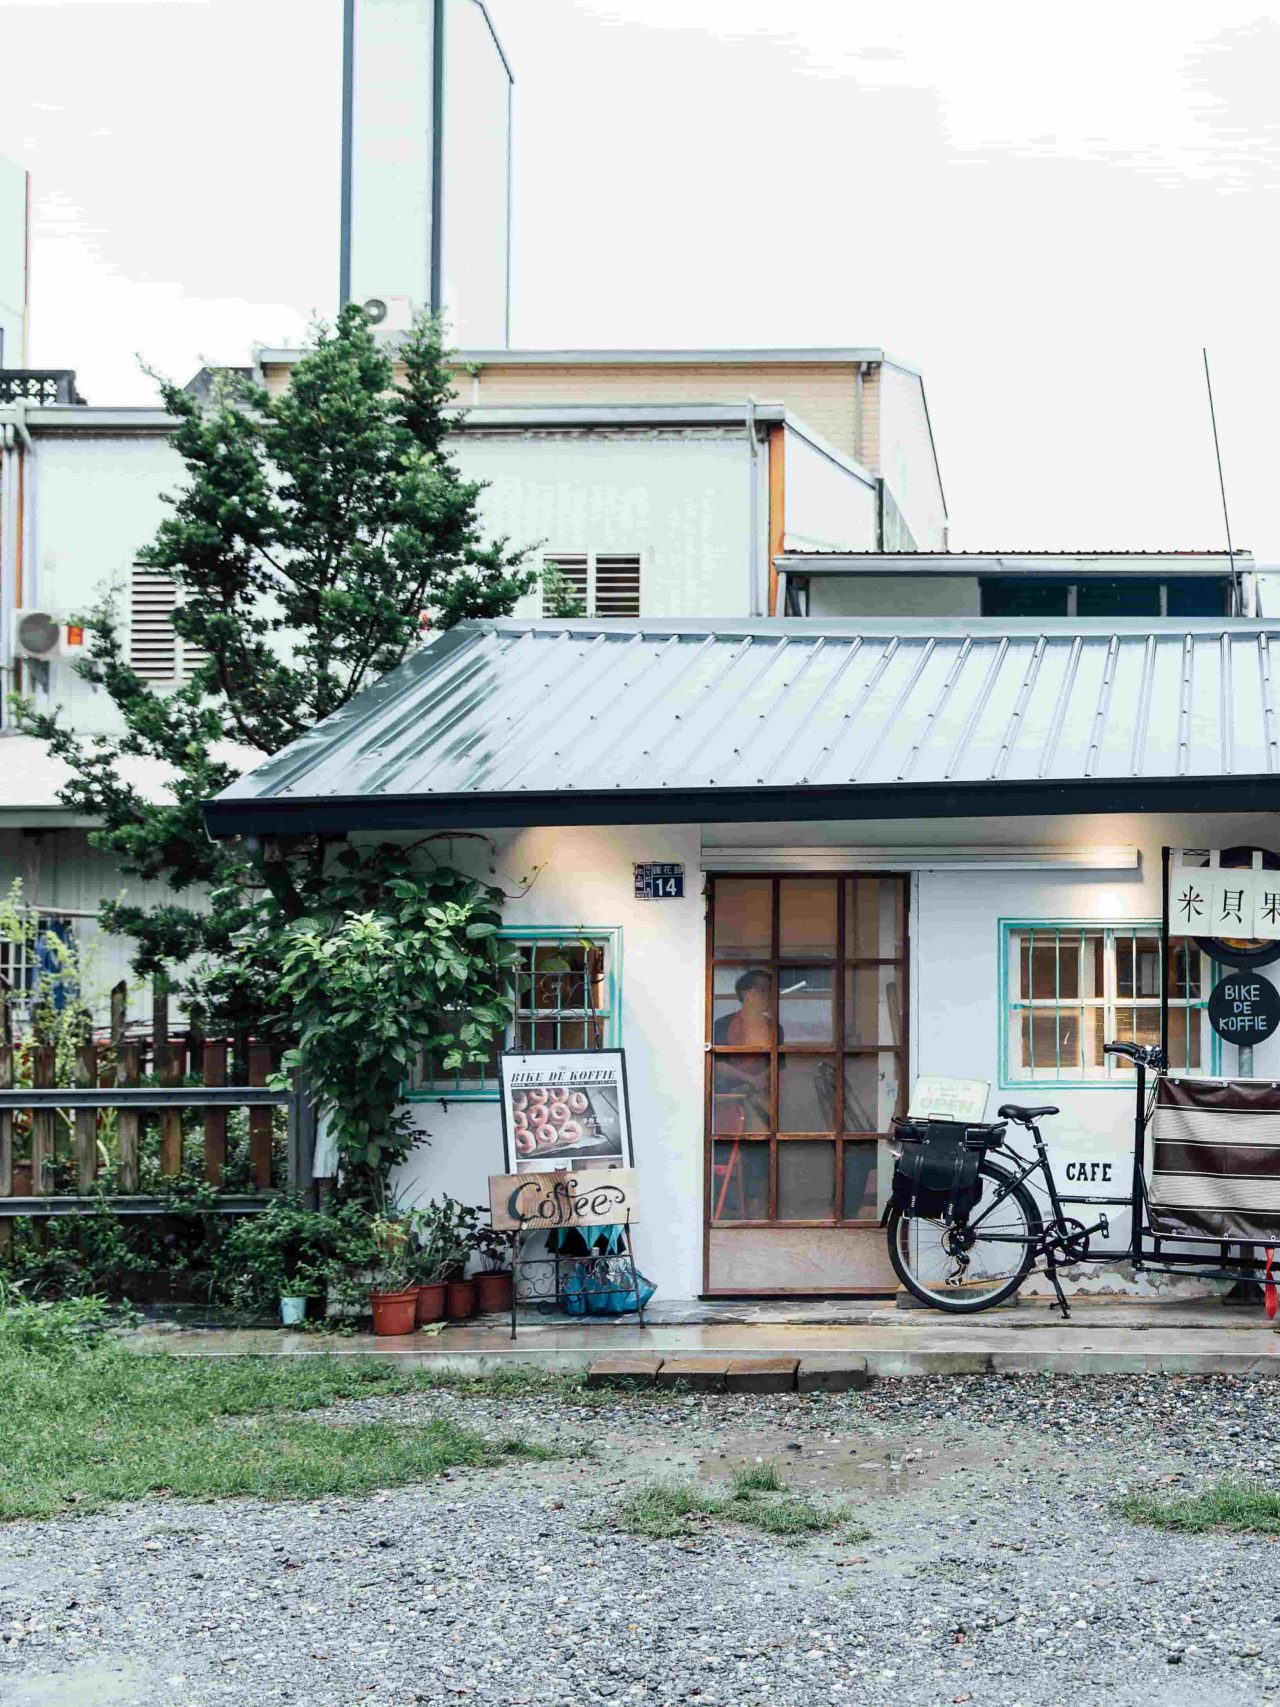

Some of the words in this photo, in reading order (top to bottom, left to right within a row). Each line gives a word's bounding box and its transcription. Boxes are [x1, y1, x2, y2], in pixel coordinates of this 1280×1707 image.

[656, 878, 678, 896] 14
[1224, 984, 1261, 1000] BIKE
[1233, 1001, 1252, 1014] DE
[1219, 1015, 1268, 1031] KOFFIE
[511, 1072, 544, 1082] BIKE
[549, 1072, 566, 1081] DE
[569, 1070, 616, 1081] KOFFIE
[920, 1097, 975, 1113] OPEN
[1066, 1162, 1112, 1182] CAFE
[507, 1179, 626, 1225] Coffee
